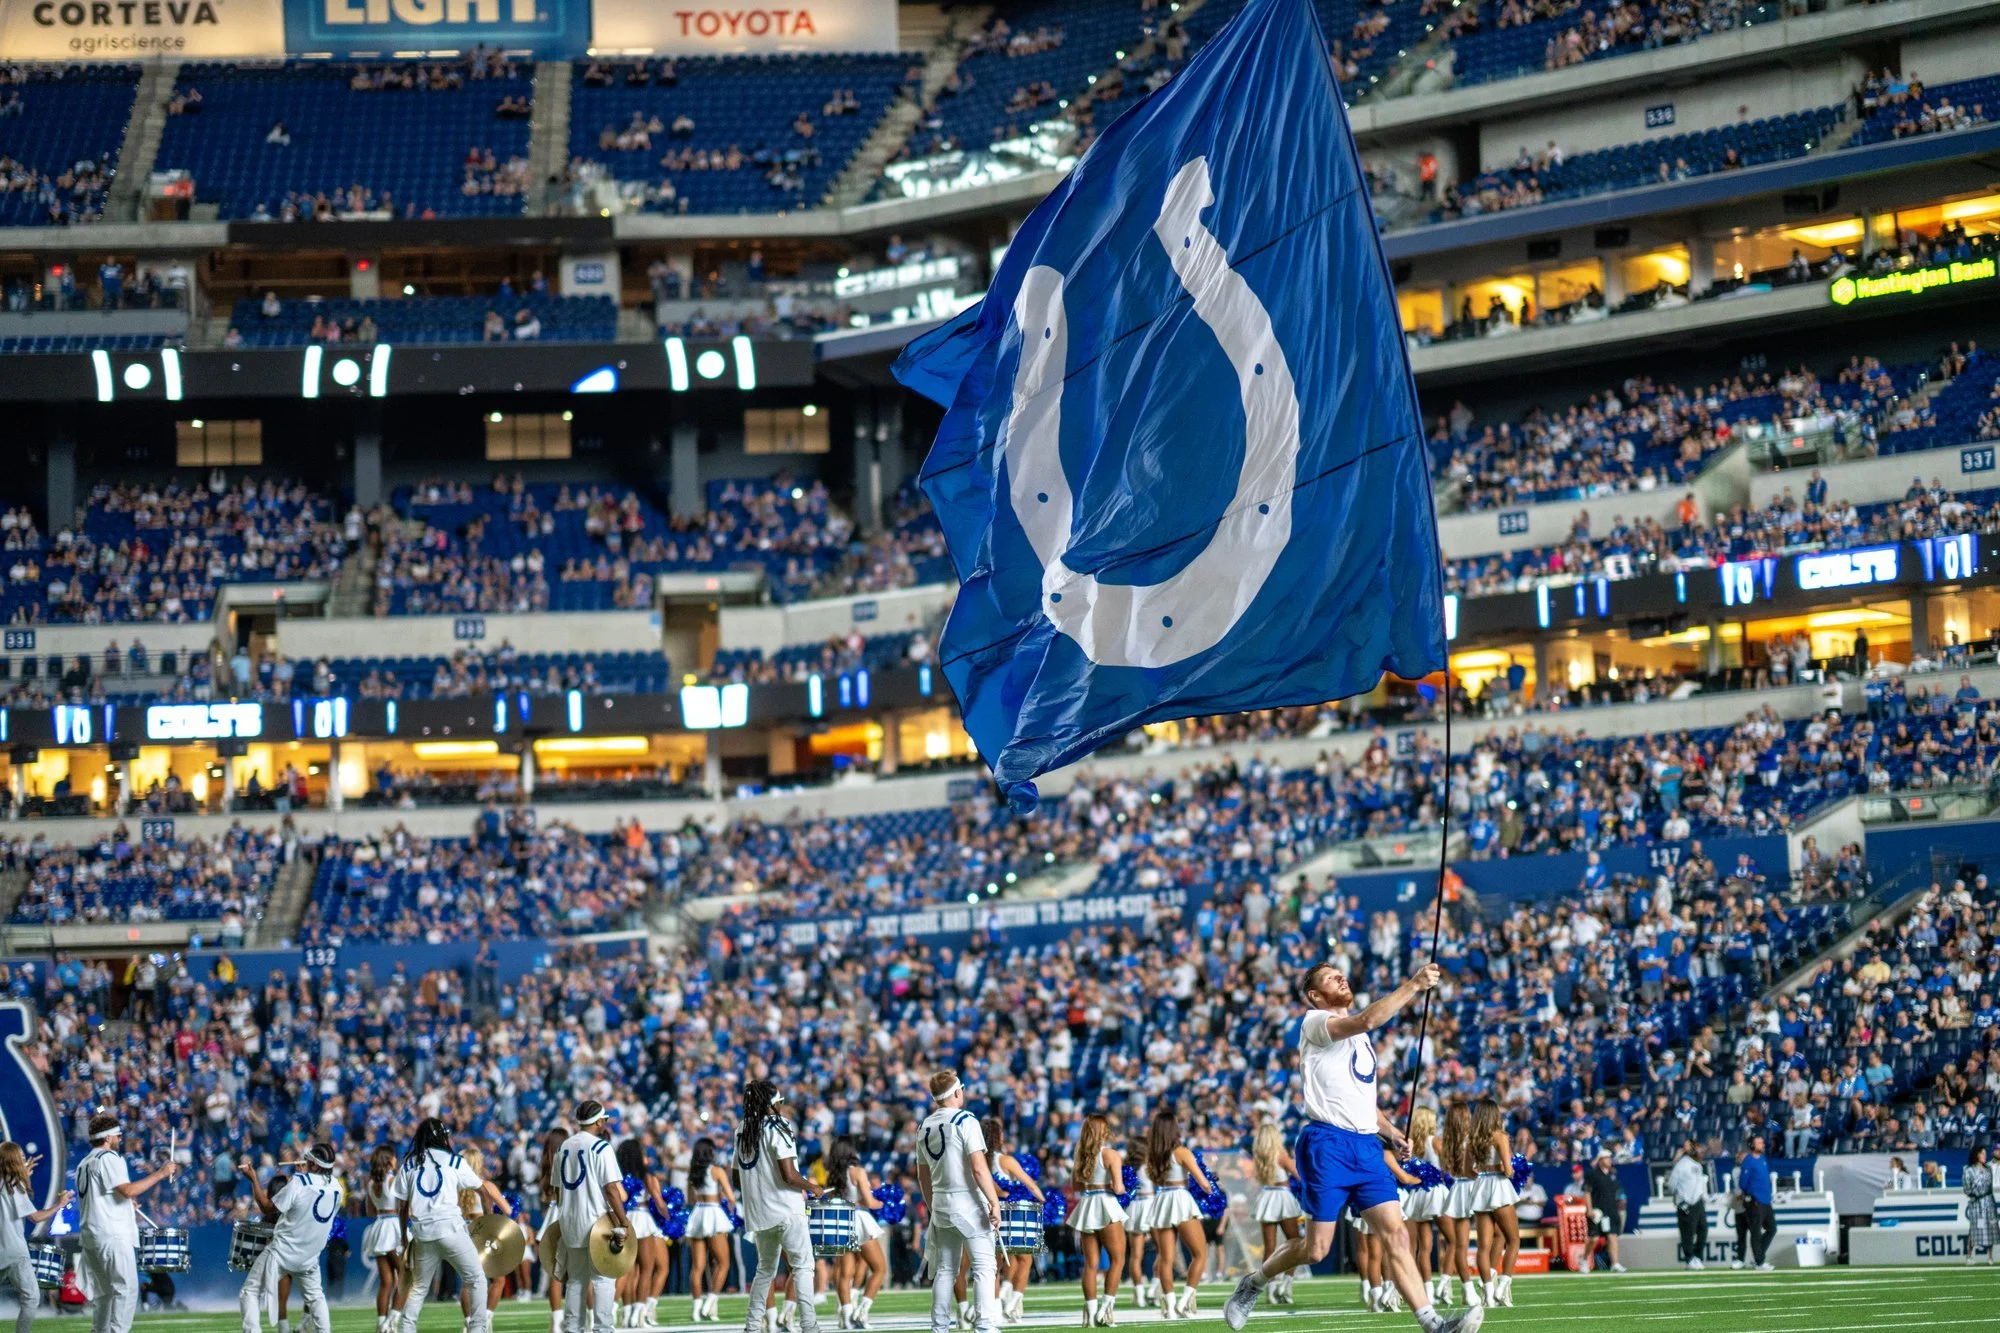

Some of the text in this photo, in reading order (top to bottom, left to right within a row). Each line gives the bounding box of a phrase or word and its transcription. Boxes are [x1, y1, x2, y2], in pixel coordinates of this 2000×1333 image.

[33, 2, 220, 26] CORTEVA
[673, 10, 817, 36] TOYOTA
[70, 34, 186, 54] agriscience
[1856, 257, 1996, 299] Huntington Bank
[1963, 451, 1992, 470] 337
[7, 633, 33, 648] 331
[1651, 847, 1680, 867] 137
[306, 948, 336, 966] 132
[1677, 1241, 1742, 1262] CLTS
